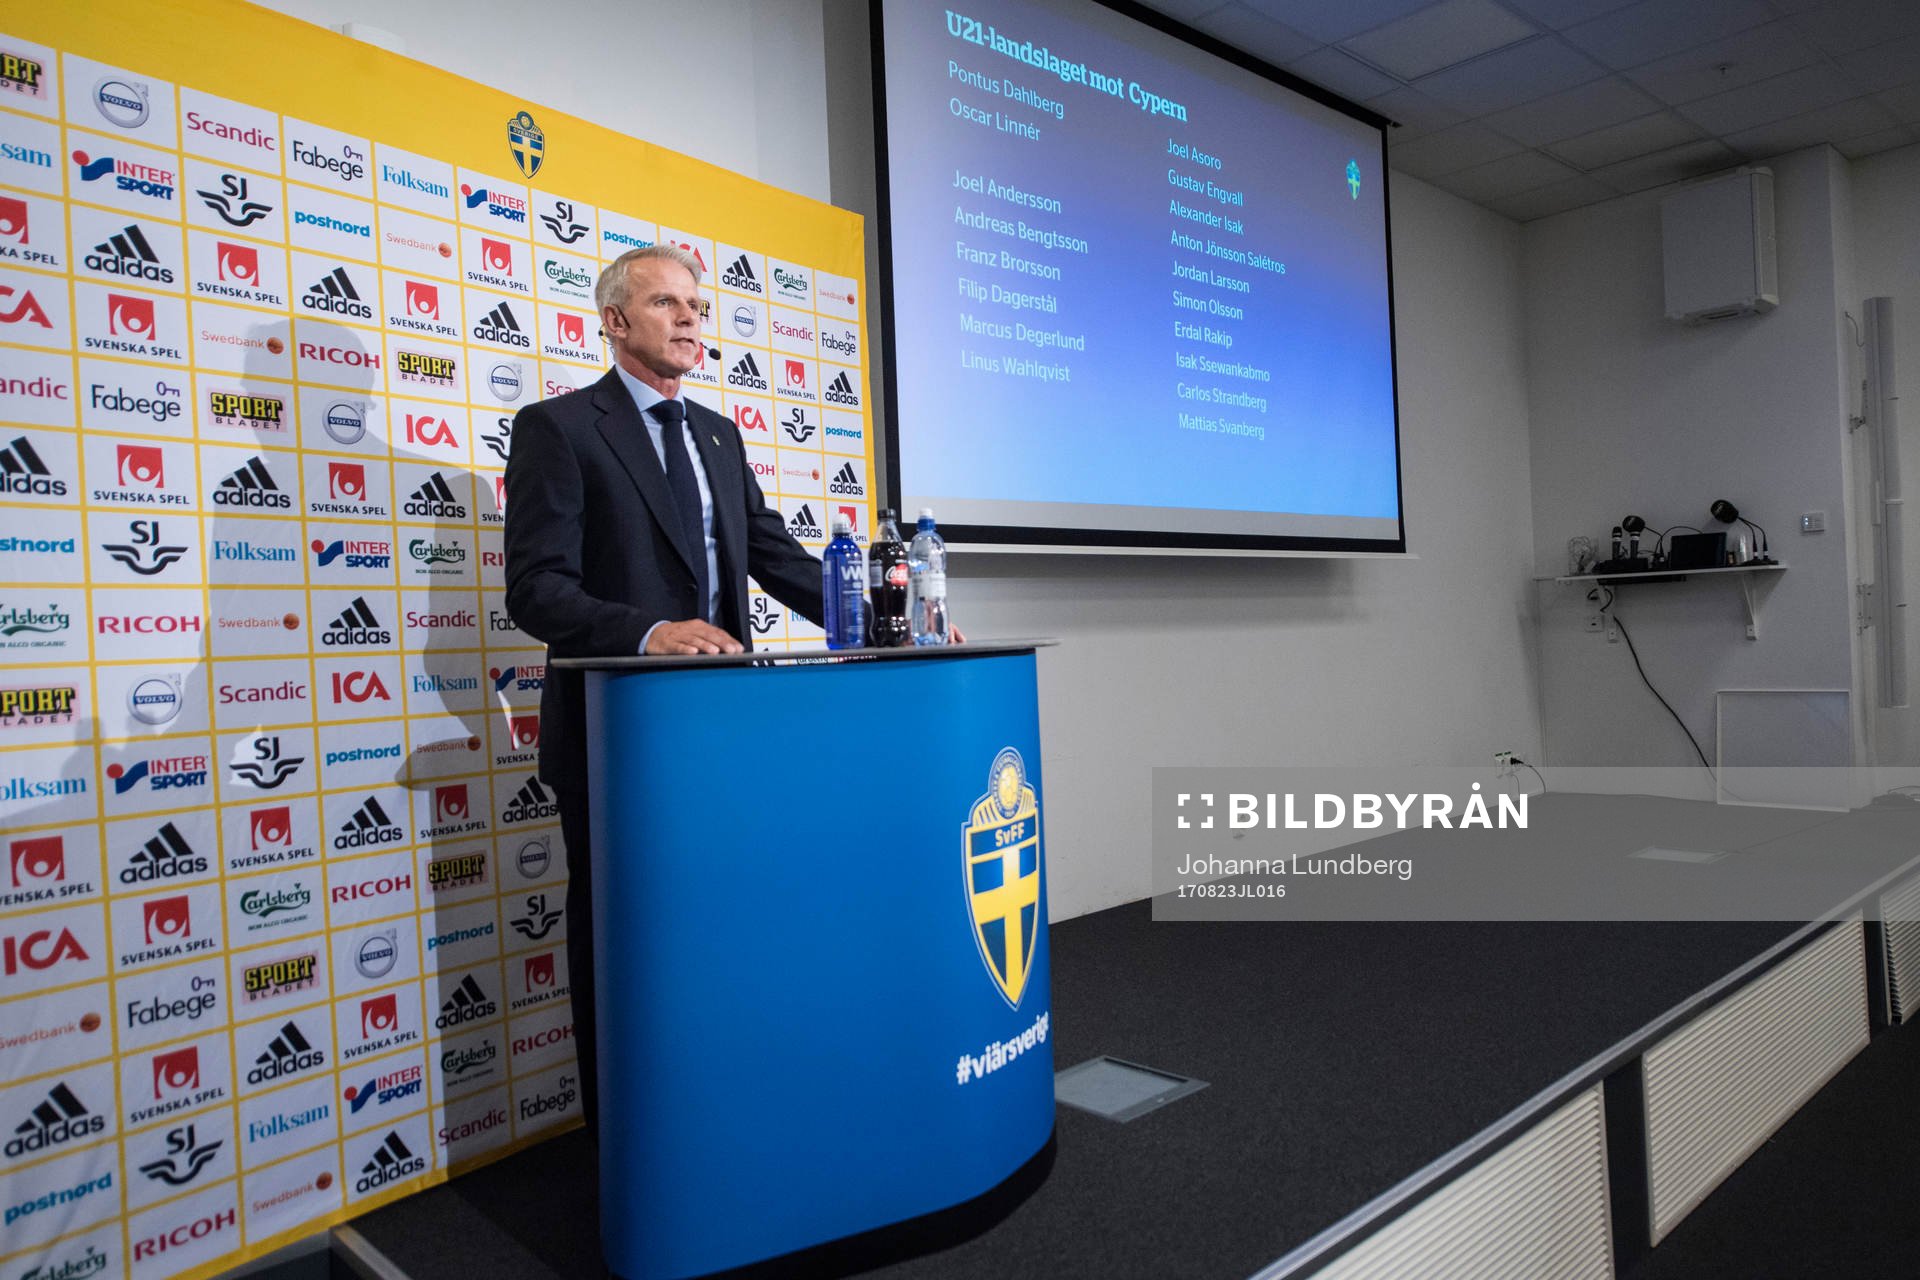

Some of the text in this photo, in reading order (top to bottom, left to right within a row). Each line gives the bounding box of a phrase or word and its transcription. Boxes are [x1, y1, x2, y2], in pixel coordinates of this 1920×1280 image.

[945, 10, 1188, 122] U21-landslaget mot Cypern
[949, 60, 1064, 119] Pontus Dahlberg
[187, 112, 275, 150] Scandic
[950, 97, 1040, 141] Oscar Linnér
[292, 140, 364, 181] Fabege
[1167, 138, 1222, 170] Joel Asoro
[117, 160, 173, 185] INTER
[383, 165, 448, 198] Folksam
[116, 176, 174, 200] SPORT
[221, 174, 248, 200] SJ
[953, 170, 1062, 214] Joel Andersson
[1168, 169, 1243, 206] Gustav Engvall
[489, 192, 525, 210] INTER
[489, 204, 526, 223] SPORT
[556, 202, 572, 222] SJ
[294, 211, 370, 238] postnord
[1170, 200, 1244, 234] Alexander Isak
[386, 232, 436, 252] Swedbank
[955, 206, 1088, 254] Andreas Bengtsson
[24, 250, 58, 265] SPEL
[957, 241, 1060, 280] Franz Brorsson
[1171, 230, 1286, 274] Anton Jönsson Salétros
[84, 255, 174, 283] adidas
[544, 260, 590, 286] Carlsberg
[1172, 260, 1250, 293] Jordan Larsson
[197, 282, 282, 304] SVENSKA SPEL
[468, 272, 528, 292] SVENSKA SPEL
[722, 274, 762, 293] adidas
[302, 293, 372, 318] adidas
[959, 278, 1057, 313] Filip Dagerstål
[1173, 291, 1243, 320] Simon Olsson
[390, 316, 458, 336] SVENSKA SPEL
[474, 326, 530, 348] adidas
[772, 321, 814, 340] Scandic
[960, 313, 1084, 351] Marcus Degerlund
[1175, 321, 1232, 349] Erdal Rakip
[86, 338, 182, 358] SVENSKA SPEL
[202, 330, 264, 349] Swedbank
[822, 332, 856, 356] Fabege
[300, 343, 380, 369] RICOH
[398, 352, 455, 379] SPORT
[545, 346, 600, 362] SVENSKA SPEL
[962, 350, 1070, 383] Linus Wahlqvist
[1176, 352, 1197, 369] Isak
[402, 374, 454, 386] BLADET
[728, 374, 767, 390] adidas
[92, 384, 180, 422] Fabege
[210, 392, 282, 422] SPORT
[825, 391, 858, 406] adidas
[1177, 382, 1267, 413] Carlos Strandberg
[216, 418, 281, 430] BLADET
[734, 404, 768, 432] ICA
[792, 408, 804, 424] SJ
[1178, 413, 1264, 440] Mattias Svanberg
[406, 414, 458, 448] ICA
[826, 426, 862, 438] postnord
[94, 490, 190, 505] SVENSKA SPEL
[213, 488, 290, 508] adidas
[830, 484, 863, 496] adidas
[312, 503, 386, 516] SVENSKA SPEL
[404, 502, 466, 518] adidas
[130, 520, 160, 545] SJ
[214, 541, 296, 561] Folksam
[346, 541, 390, 554] INTER
[346, 555, 390, 568] SPORT
[98, 616, 200, 634] RICOH
[218, 618, 280, 628] Swedbank
[407, 611, 476, 628] Scandic
[322, 628, 390, 645] adidas
[220, 682, 306, 704] Scandic
[332, 671, 390, 704] ICA
[414, 674, 478, 692] Folksam
[135, 694, 175, 704] VOLVO
[254, 737, 280, 760] SJ
[326, 744, 400, 766] postnord
[497, 754, 534, 765] SVENSKA
[151, 756, 207, 773] INTER
[150, 771, 207, 790] SPORT
[502, 803, 558, 824] adidas
[334, 828, 402, 850] adidas
[420, 820, 486, 838] SVENSKA SPEL
[995, 822, 1024, 847] SvFF
[120, 856, 208, 884] adidas
[231, 848, 314, 869] SVENSKA SPEL
[428, 856, 485, 883] SPORT
[60, 884, 94, 896] SPEL
[240, 883, 310, 918] Carlsberg
[332, 874, 411, 904] RICOH
[527, 894, 545, 915] SJ
[428, 922, 494, 950] postnord
[4, 926, 89, 976] ICA
[121, 938, 216, 966] SVENSKA SPEL
[244, 955, 317, 992] SPORT
[128, 991, 216, 1028] Fabege
[512, 994, 550, 1010] SVENSKA
[436, 1002, 496, 1030] adidas
[344, 1031, 418, 1059] SVENSKA SPEL
[512, 1024, 576, 1055] RICOH
[247, 1049, 324, 1086] adidas
[378, 1066, 421, 1088] INTER
[378, 1080, 422, 1104] SPORT
[520, 1088, 576, 1121] Fabege
[131, 1088, 225, 1123] SVENSKA SPEL
[4, 1114, 105, 1158] adidas
[249, 1105, 329, 1143] Folksam
[439, 1109, 506, 1146] Scandic
[167, 1124, 195, 1155] SJ
[356, 1156, 425, 1194] adidas
[5, 1172, 112, 1226] postnord
[252, 1183, 314, 1214] Swedbank
[134, 1208, 235, 1262] RICOH
